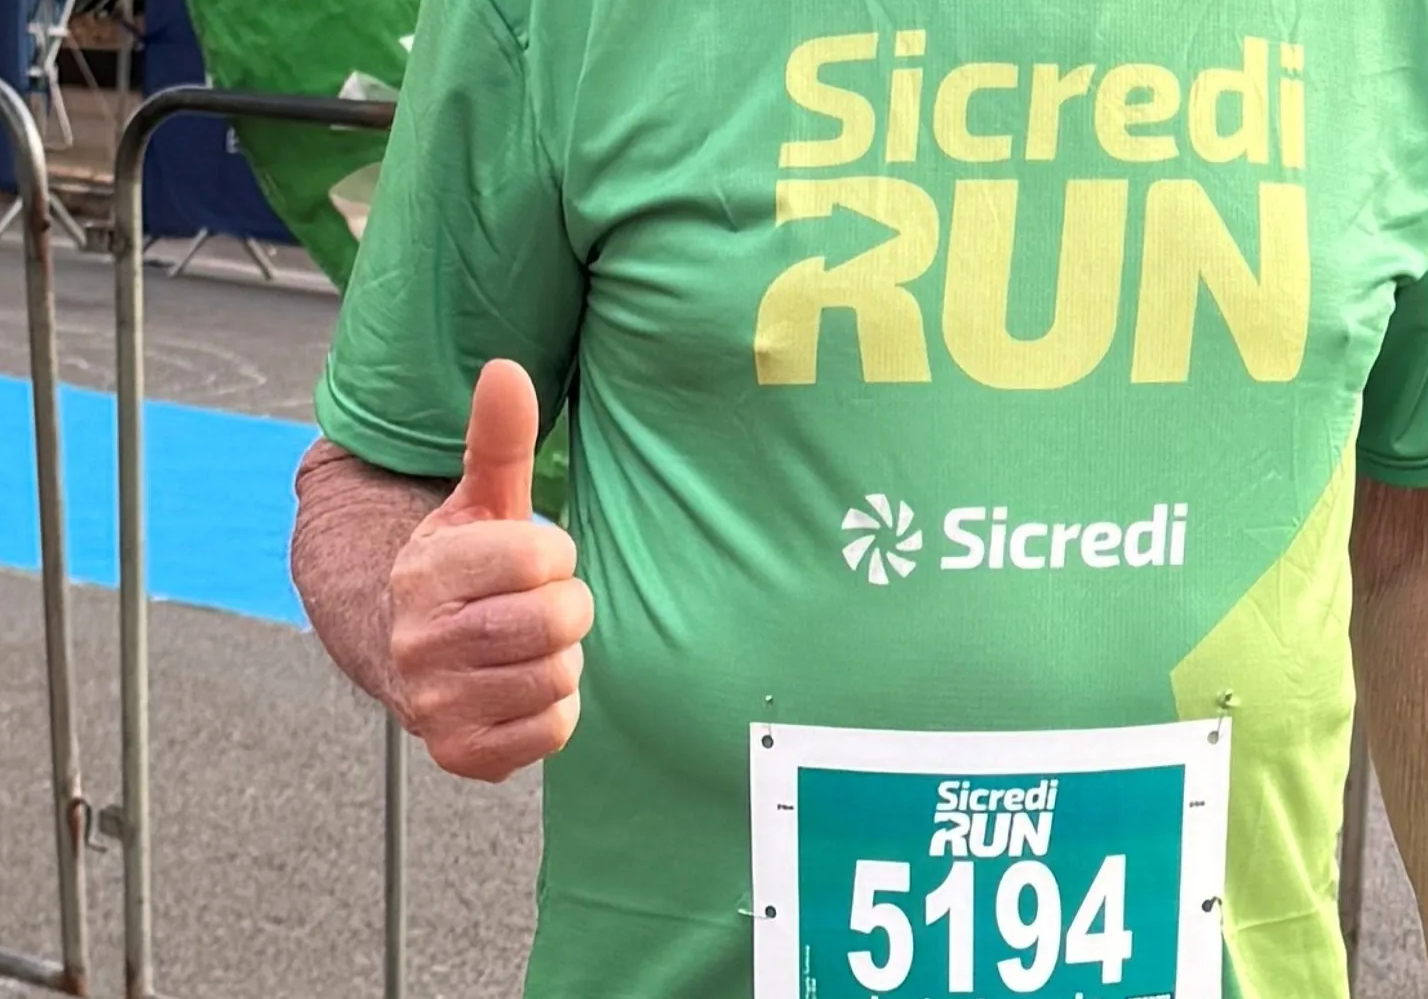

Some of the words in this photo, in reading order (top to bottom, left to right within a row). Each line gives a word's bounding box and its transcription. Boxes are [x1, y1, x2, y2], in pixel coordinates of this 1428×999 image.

[777, 29, 1307, 169] Sicredi
[755, 176, 1311, 390] RUN
[939, 502, 1188, 571] Sicredi
[928, 811, 1054, 858] RUN
[935, 778, 1059, 812] Sicredi
[847, 854, 1133, 994] 5194
